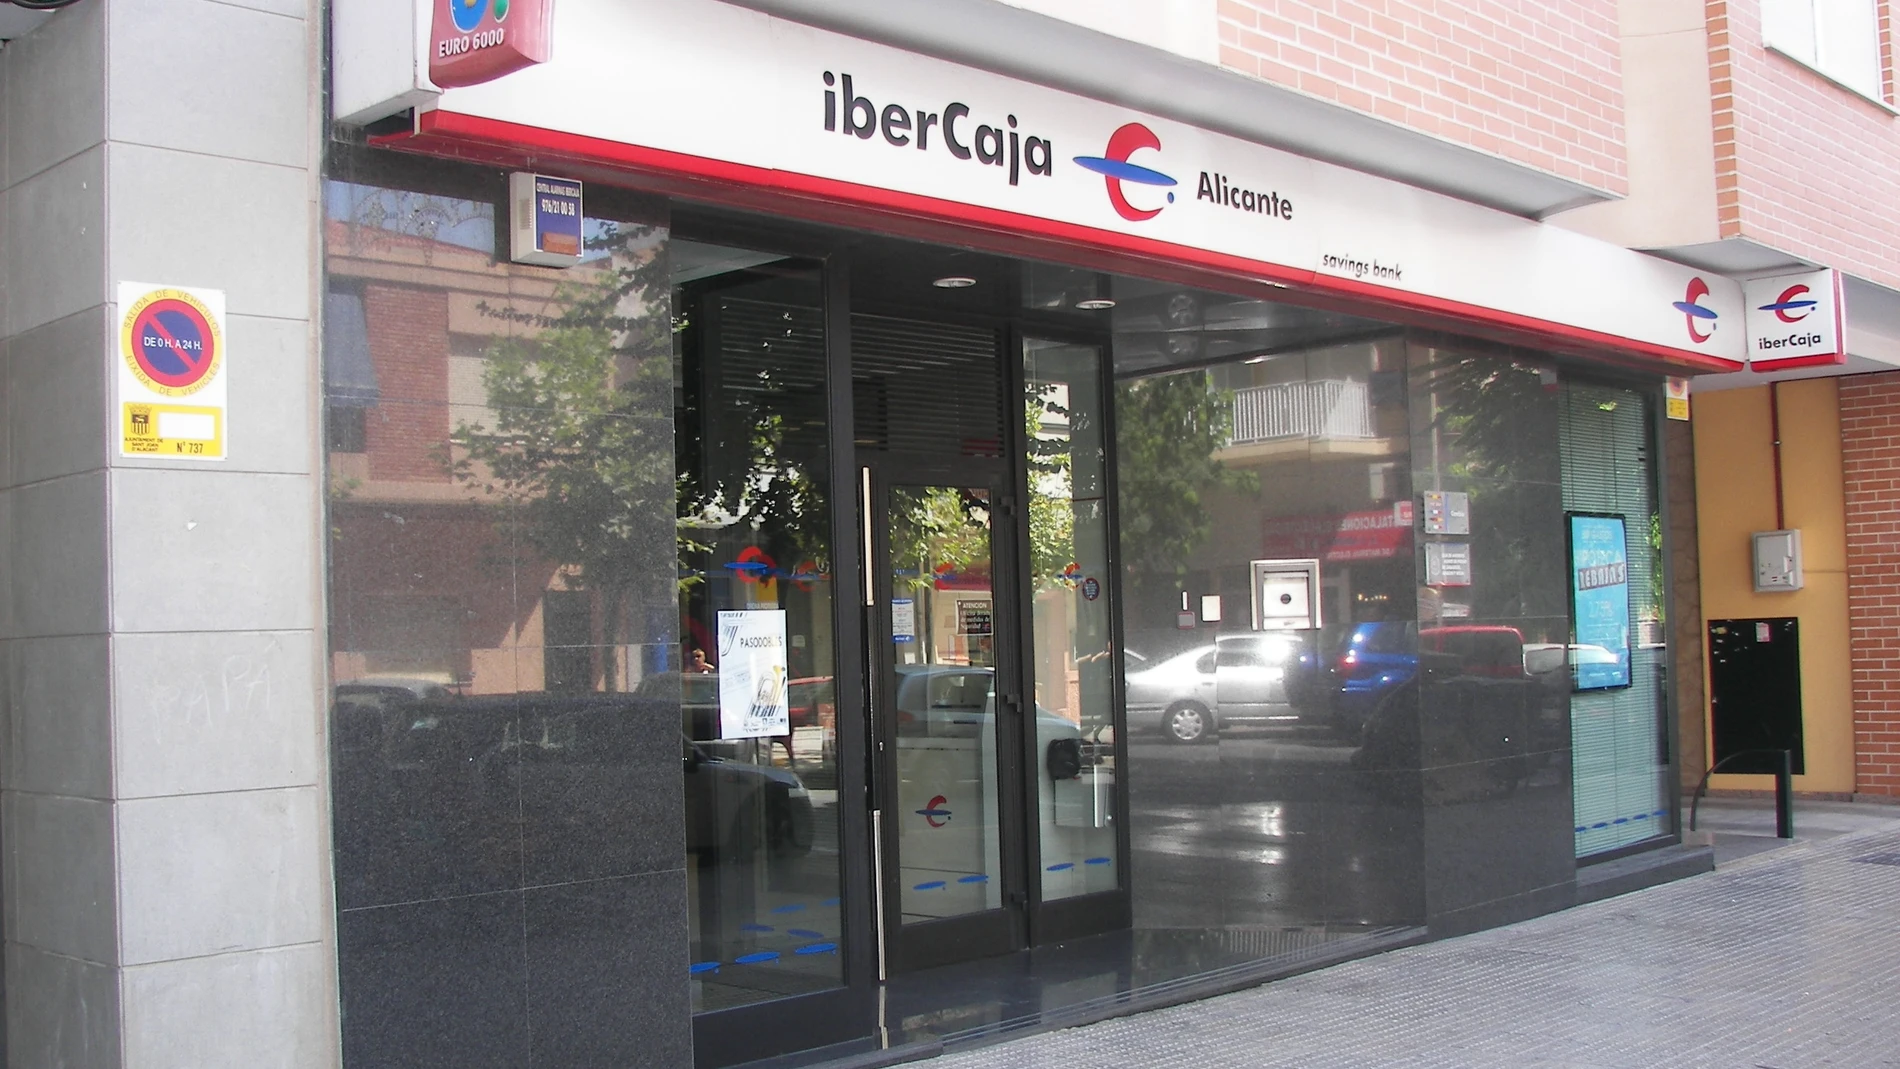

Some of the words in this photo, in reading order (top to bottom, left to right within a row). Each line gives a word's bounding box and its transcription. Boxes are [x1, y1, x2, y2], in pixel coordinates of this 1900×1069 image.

[439, 36, 469, 57] EURO
[473, 28, 504, 50] 6000
[823, 70, 1052, 186] iberCaja
[1197, 171, 1293, 221] Alicante
[1323, 253, 1368, 278] savings
[1373, 259, 1402, 281] bank
[124, 296, 149, 329] SALIDA
[154, 289, 168, 298] DE
[143, 336, 156, 347] DE
[174, 339, 183, 349] A
[183, 340, 192, 350] 24
[1758, 332, 1821, 350] iberCaja
[126, 355, 151, 387] EIXIDA
[159, 386, 172, 397] DE
[181, 363, 220, 396] VEHICLES
[188, 442, 204, 454] 737
[740, 636, 783, 649] PASODOBS
